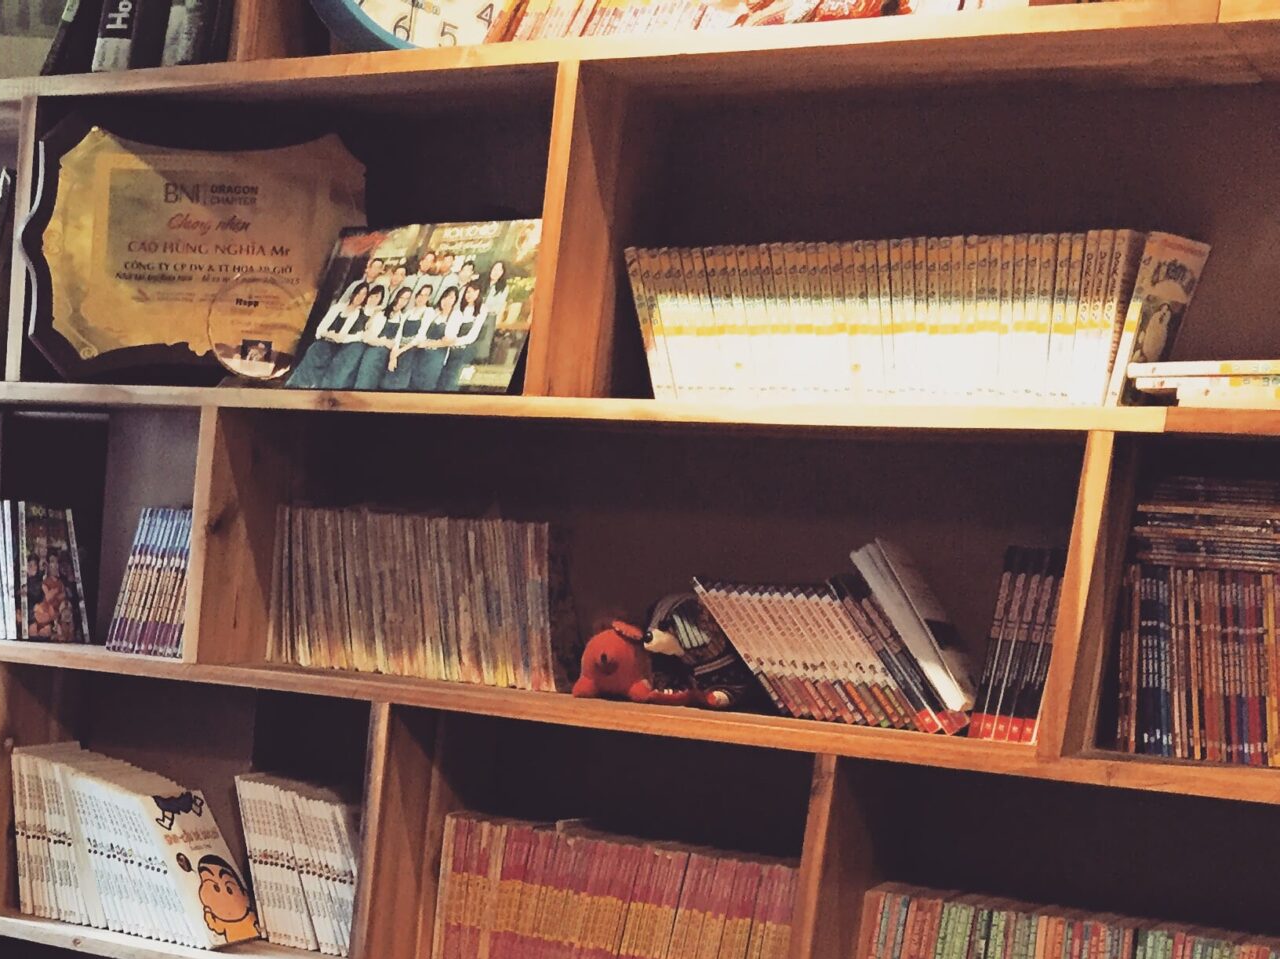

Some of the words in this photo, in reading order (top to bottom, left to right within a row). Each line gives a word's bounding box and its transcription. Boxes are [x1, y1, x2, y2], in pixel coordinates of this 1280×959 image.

[106, 0, 132, 30] Ho
[476, 3, 494, 28] 4
[393, 15, 410, 42] 6
[439, 21, 458, 48] 5
[164, 182, 200, 204] BNI
[210, 184, 259, 196] DRAGON
[210, 196, 257, 206] CHAPTER
[127, 240, 158, 254] CAO
